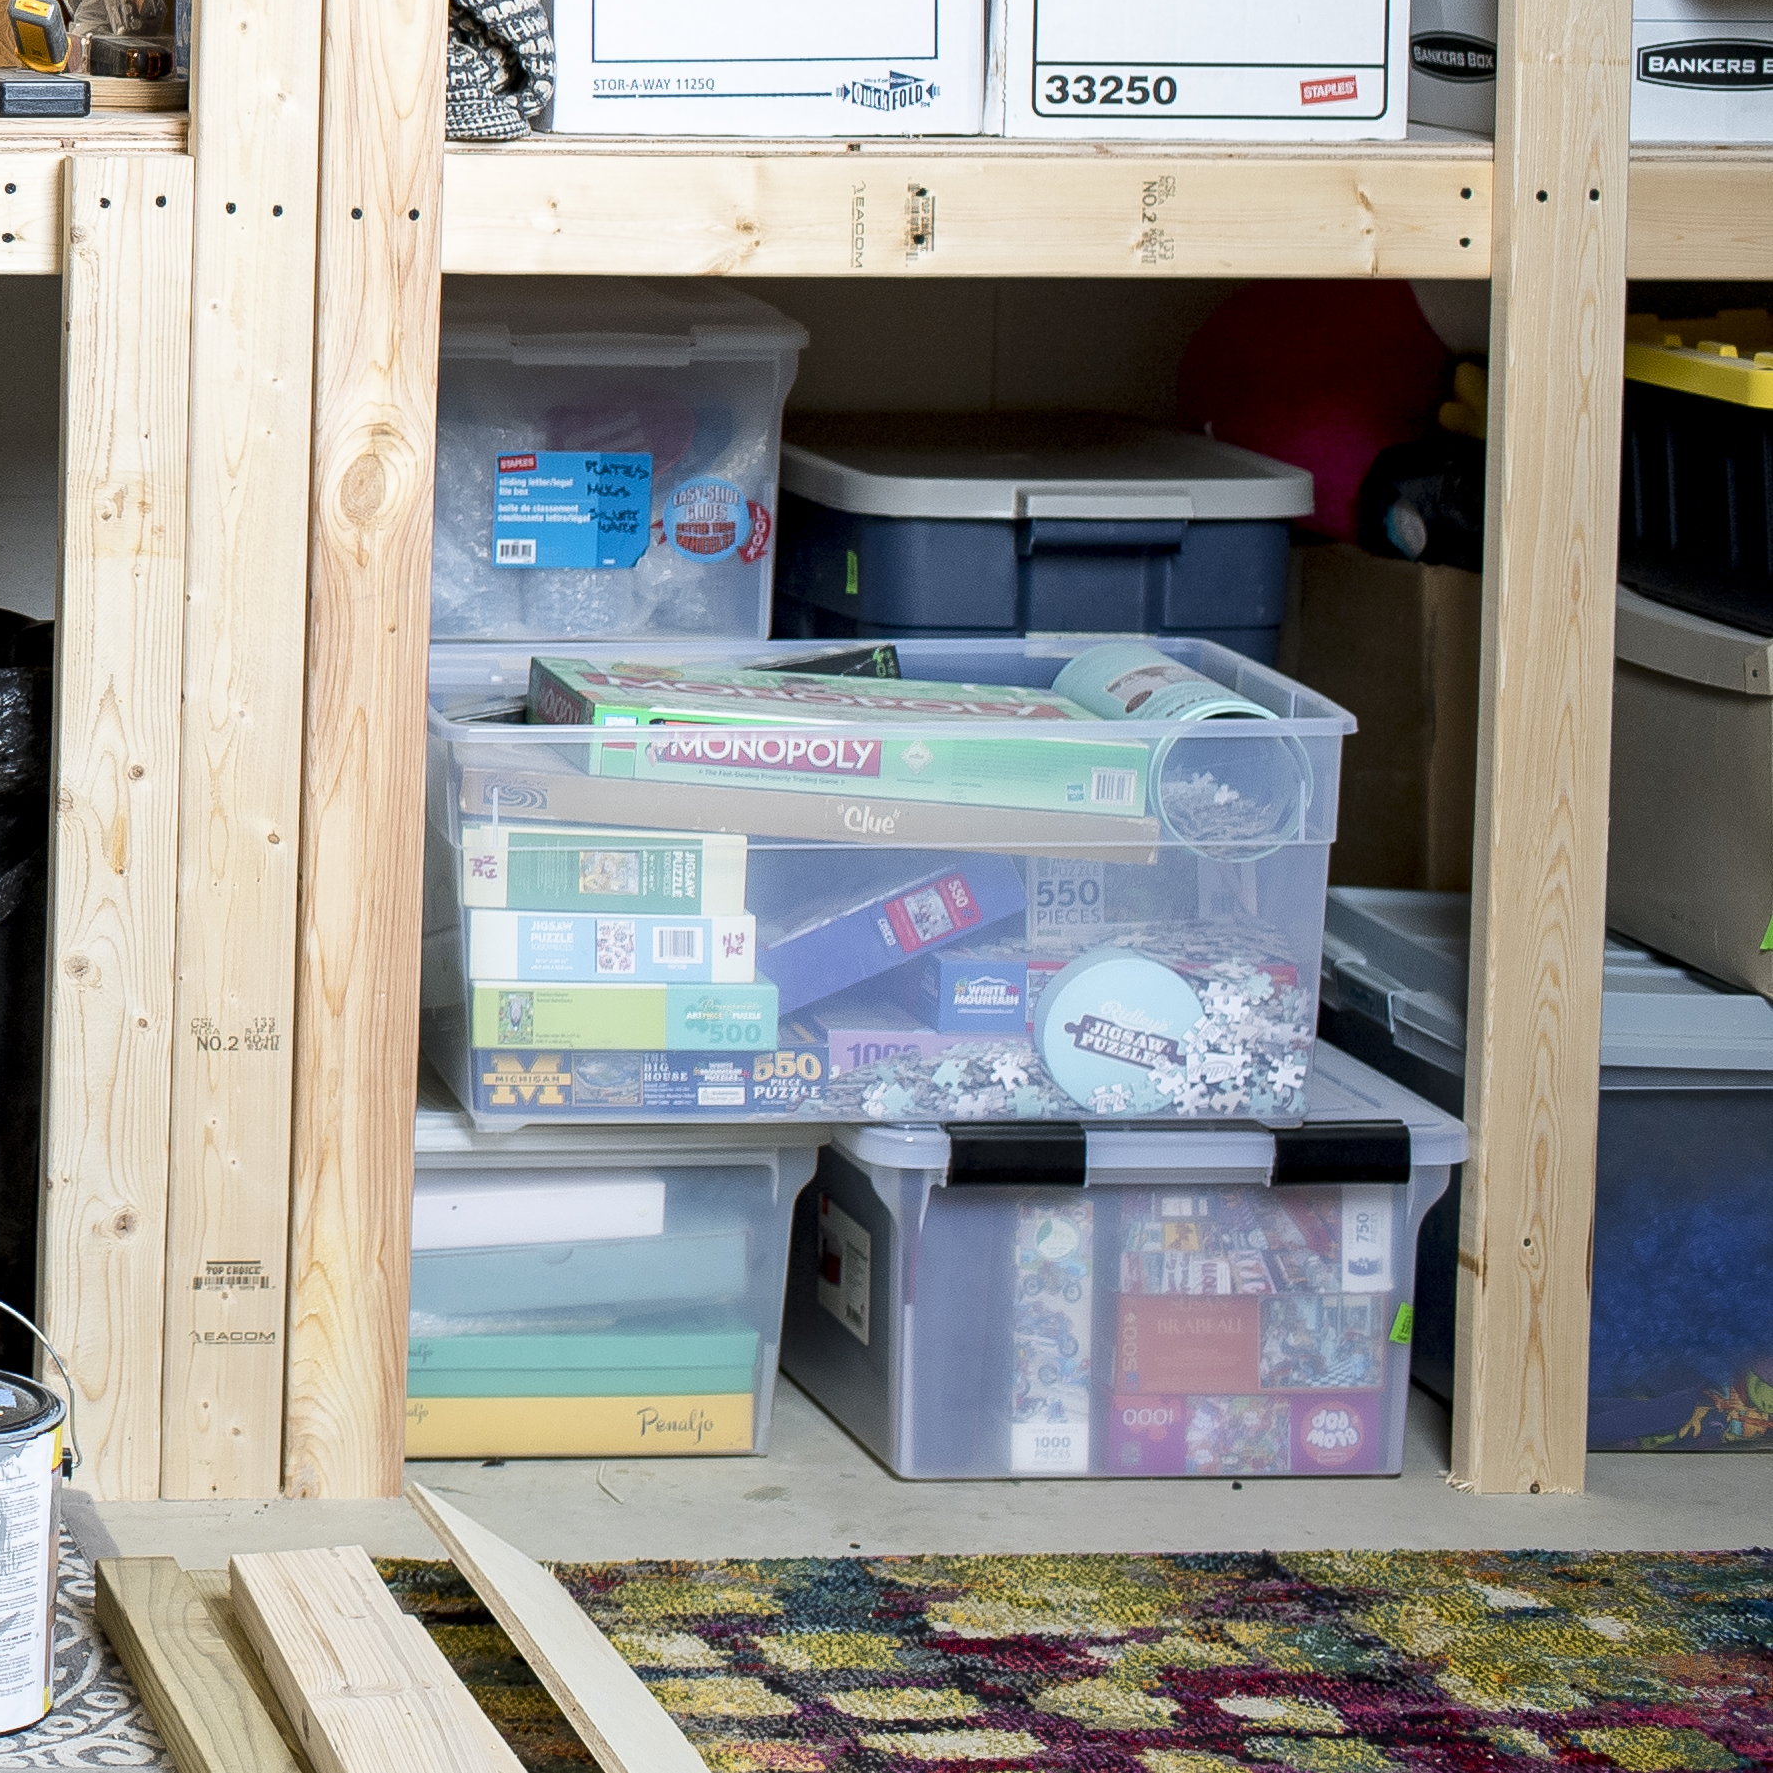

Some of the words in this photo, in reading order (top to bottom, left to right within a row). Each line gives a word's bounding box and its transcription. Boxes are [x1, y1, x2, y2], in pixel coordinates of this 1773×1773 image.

[1414, 46, 1465, 67] BANKERS
[1467, 53, 1494, 68] BOX
[1648, 57, 1757, 74] BANKERS
[593, 79, 672, 92] STOR-A-WAY
[676, 78, 716, 92] 1125Q
[1045, 75, 1177, 106] 33250
[1304, 82, 1356, 99] STAPLES
[852, 80, 891, 112] QUICK
[891, 83, 923, 111] FOLD
[1142, 181, 1157, 223] NO.2
[855, 197, 864, 268] EACOM
[669, 732, 875, 771] MONOPOLY
[672, 851, 683, 898] PUZZLE
[685, 851, 696, 898] JIGSAW
[1037, 879, 1100, 908] 550
[1037, 908, 1101, 925] PIECES
[531, 921, 573, 931] JIGSAW
[531, 932, 573, 944] PUZZLE
[968, 984, 1008, 995] WHITE
[954, 994, 1020, 1006] MOUNTAIN
[253, 1017, 276, 1028] 133
[705, 1024, 761, 1044] 500
[1088, 1020, 1169, 1054] JIGSAW
[196, 1036, 239, 1051] NO.2
[644, 1062, 669, 1072] BIG
[753, 1051, 822, 1082] 550
[494, 1074, 560, 1085] MICHIGAN
[644, 1072, 688, 1082] HOUSE
[206, 1266, 225, 1275] TOP
[204, 1332, 276, 1341] EACOM
[1122, 1408, 1173, 1426] 1000
[637, 1407, 714, 1445] Penaljo
[1034, 1436, 1071, 1449] 1000
